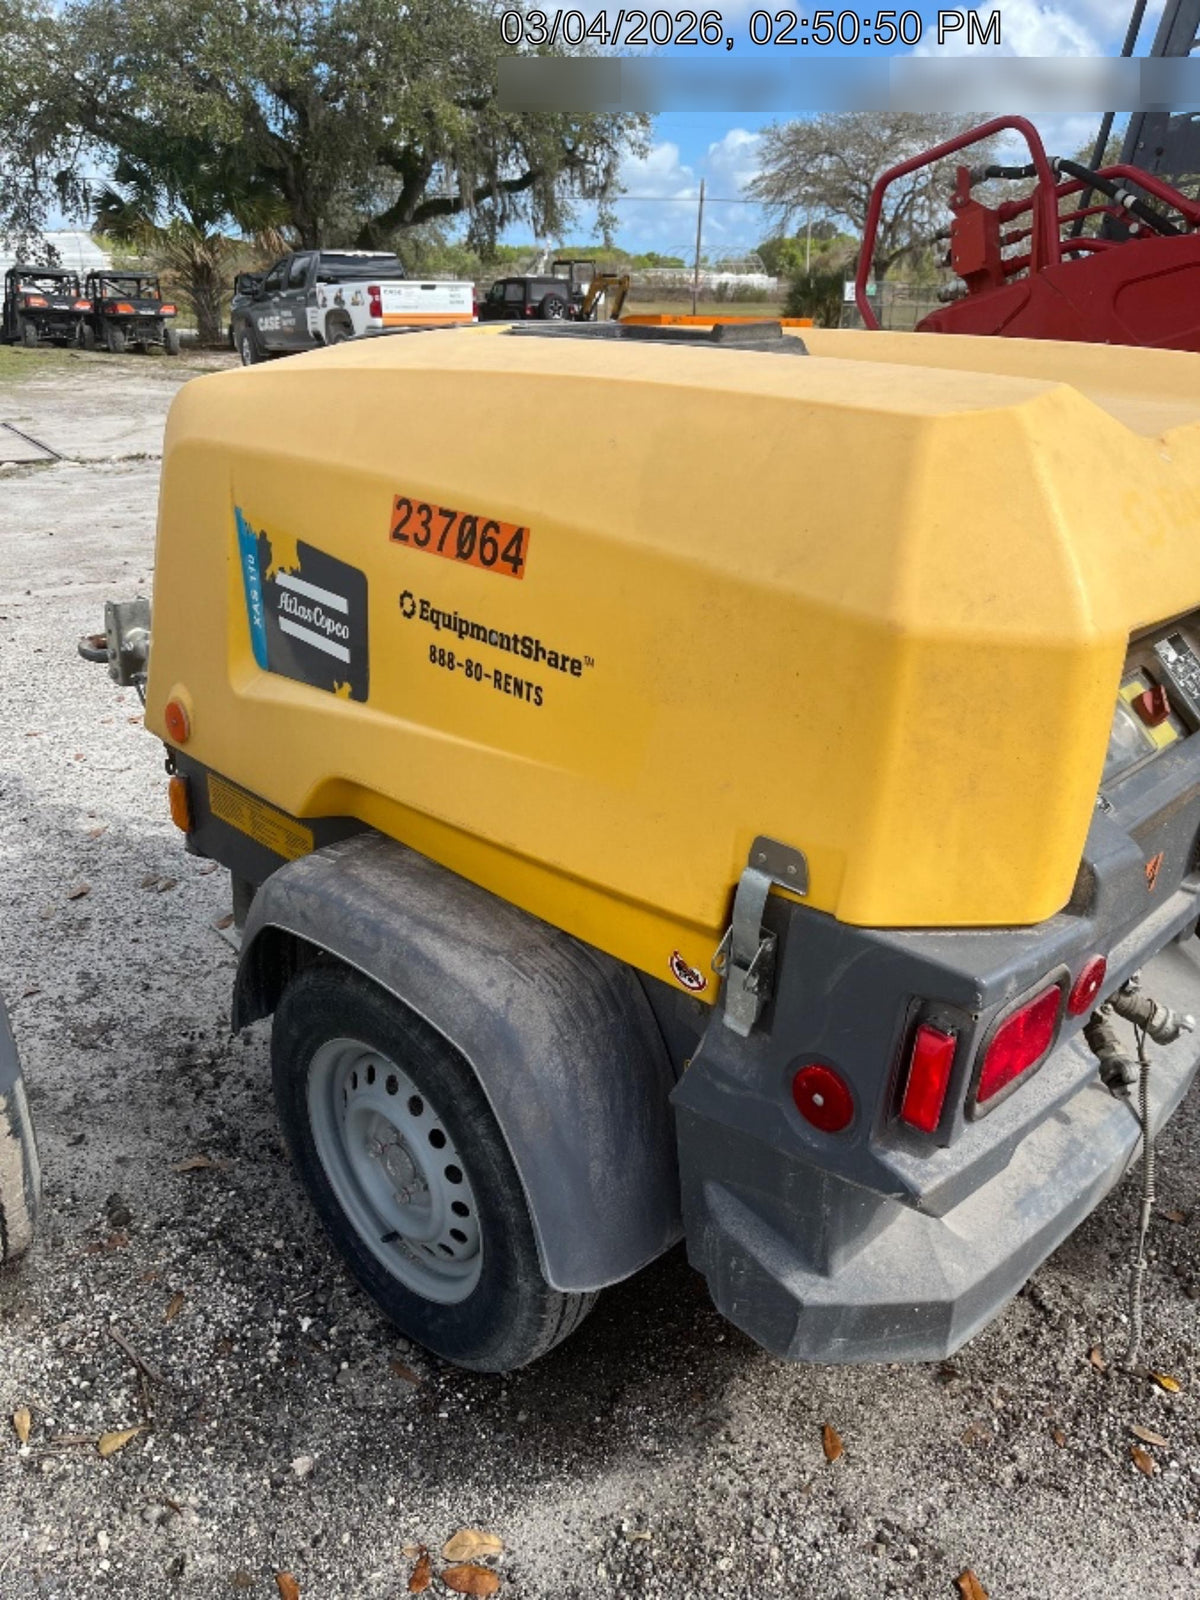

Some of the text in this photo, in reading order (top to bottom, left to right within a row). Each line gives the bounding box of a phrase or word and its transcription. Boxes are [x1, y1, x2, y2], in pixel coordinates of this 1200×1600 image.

[257, 316, 281, 331] CASE
[391, 497, 525, 574] 237064
[250, 589, 262, 629] XAS
[429, 644, 543, 707] 888-80-RENTS
